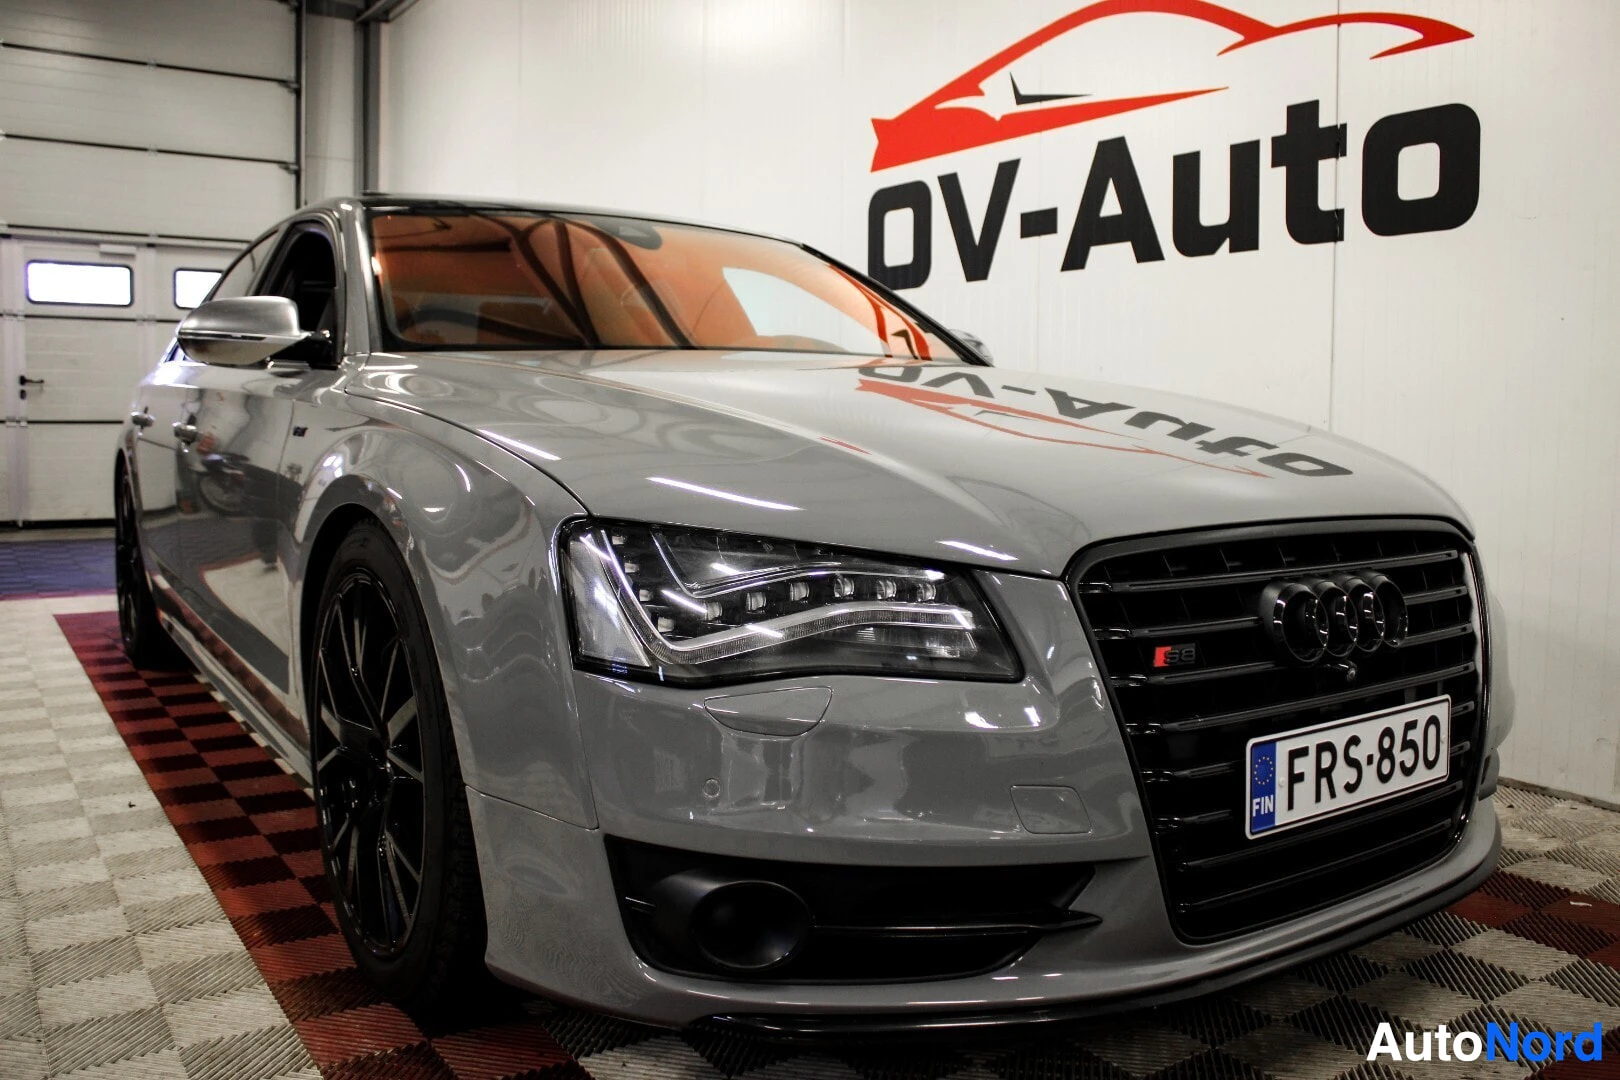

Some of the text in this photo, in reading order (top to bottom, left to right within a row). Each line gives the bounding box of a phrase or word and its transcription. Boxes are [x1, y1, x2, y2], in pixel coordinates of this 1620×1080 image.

[867, 99, 1481, 291] OV-Auto
[1252, 795, 1274, 817] FIN
[1287, 714, 1441, 811] FRS-850
